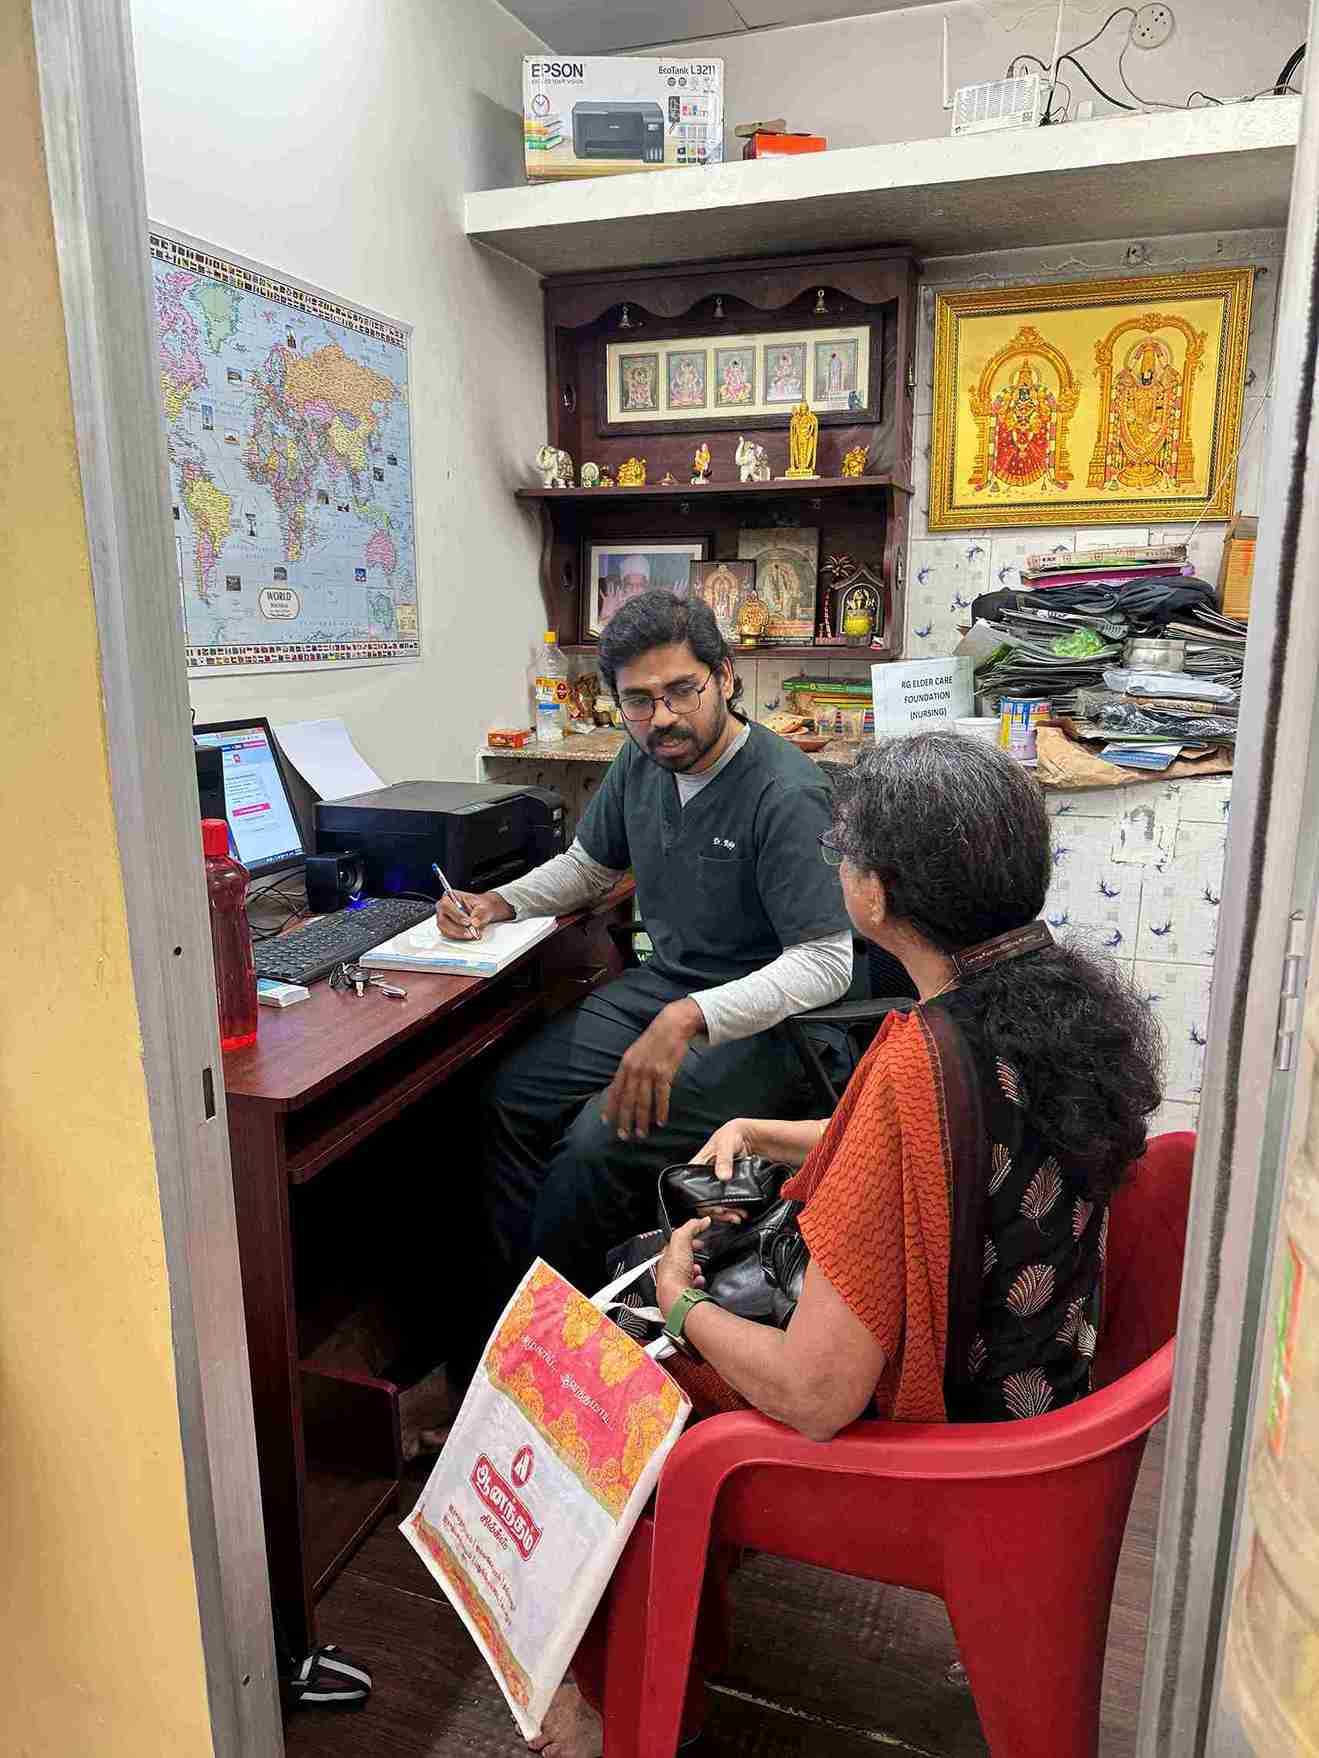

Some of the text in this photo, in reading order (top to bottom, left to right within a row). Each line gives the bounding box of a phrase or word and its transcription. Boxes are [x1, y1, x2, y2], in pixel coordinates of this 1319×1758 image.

[531, 63, 583, 78] EPSON
[658, 65, 716, 75] EcoTank L3211
[266, 591, 292, 601] WORLD
[912, 678, 934, 688] ELDER
[934, 676, 953, 686] CARE
[903, 690, 951, 704] FOUNDATION
[910, 708, 947, 720] (NURSING)
[475, 1463, 535, 1552] ஆனந்தம்
